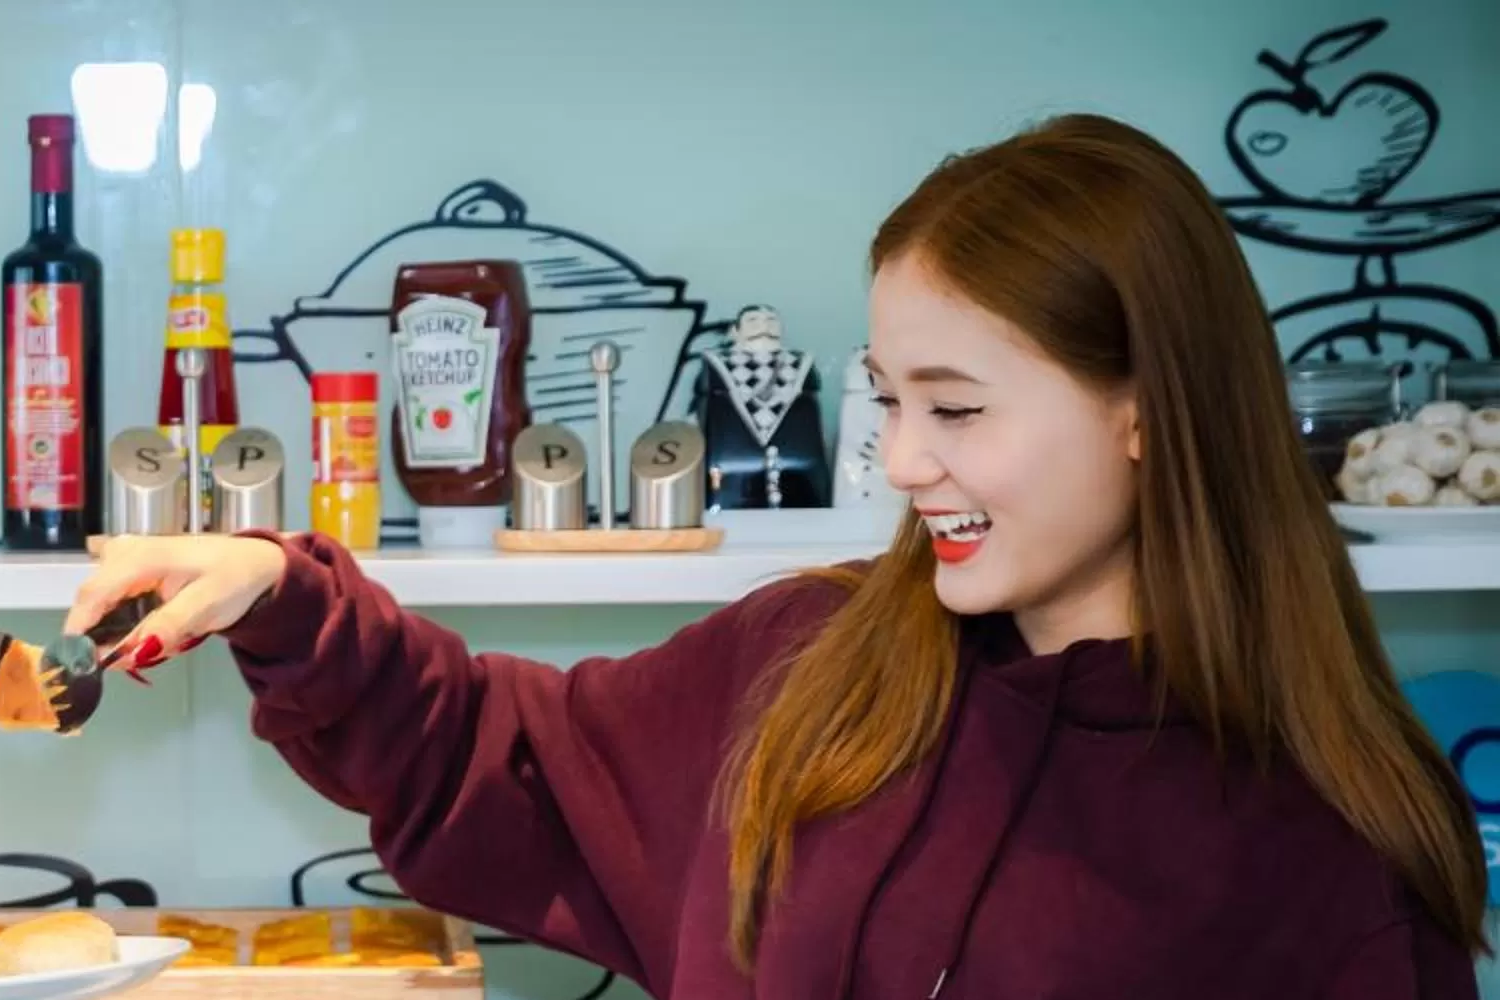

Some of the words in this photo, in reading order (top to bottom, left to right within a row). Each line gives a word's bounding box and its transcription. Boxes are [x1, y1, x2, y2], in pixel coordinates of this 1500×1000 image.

[414, 317, 468, 337] HEINZ
[406, 349, 480, 369] TOMATO
[410, 369, 475, 385] KETCHUP
[136, 446, 161, 473] S
[238, 445, 264, 472] P
[541, 443, 569, 469] P
[651, 440, 680, 465] S
